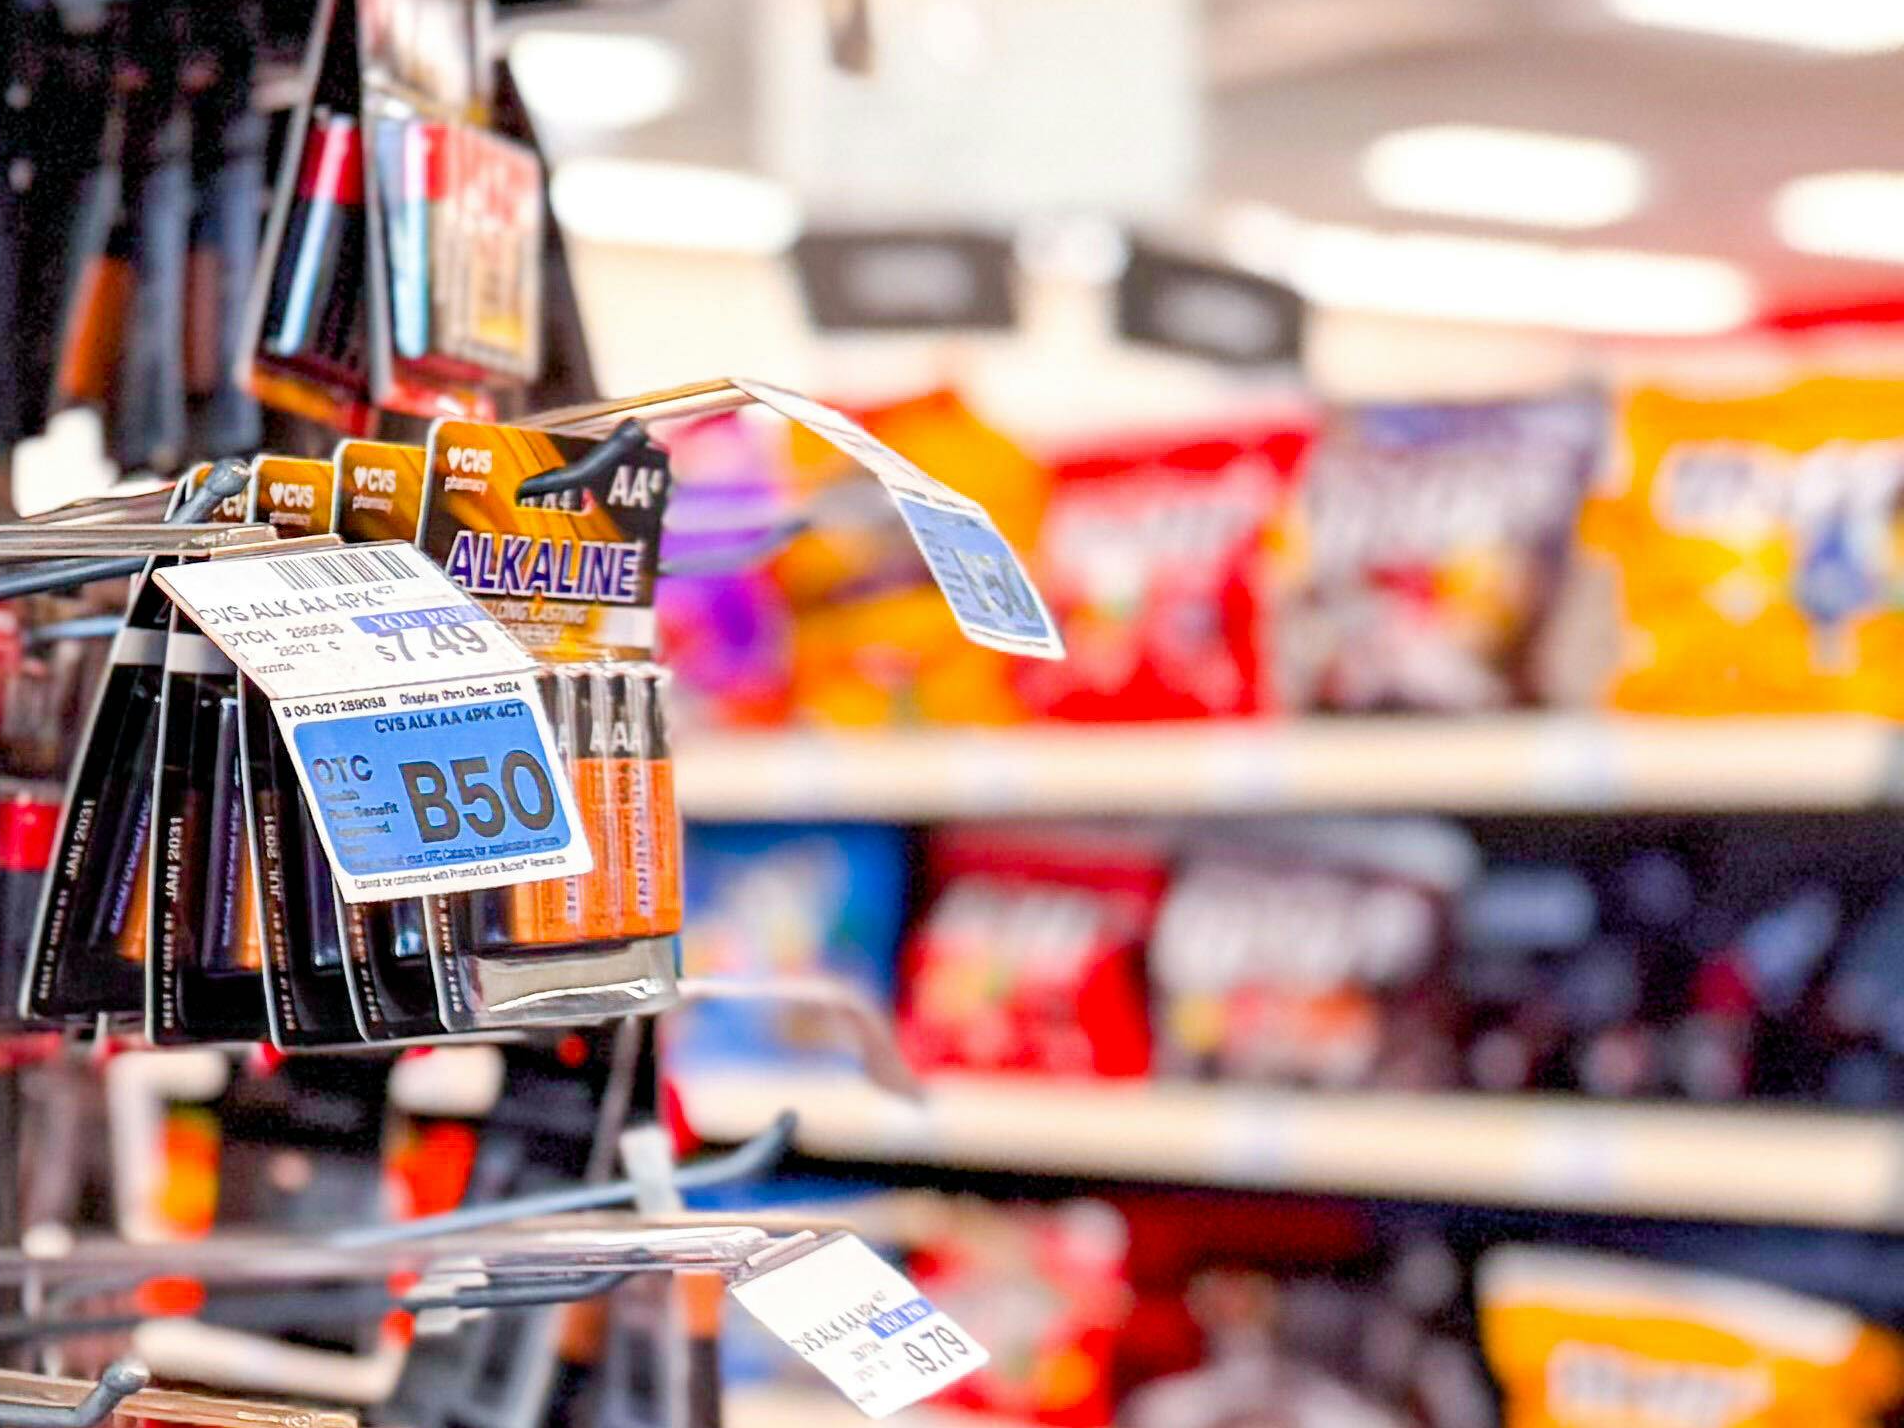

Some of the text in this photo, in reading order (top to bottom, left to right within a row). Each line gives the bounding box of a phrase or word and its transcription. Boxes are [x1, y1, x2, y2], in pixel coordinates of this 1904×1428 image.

[462, 448, 492, 473] CVS
[367, 467, 396, 492] CVS
[285, 484, 315, 509] CVS
[446, 530, 642, 602] ALKALINE
[200, 591, 381, 626] CVS ALK AA 4PK
[376, 626, 488, 663] $7.49
[494, 681, 521, 694] 2024
[375, 712, 463, 734] CVS AA
[312, 755, 373, 786] OTC
[398, 749, 555, 843] B50
[167, 816, 184, 862] 2031
